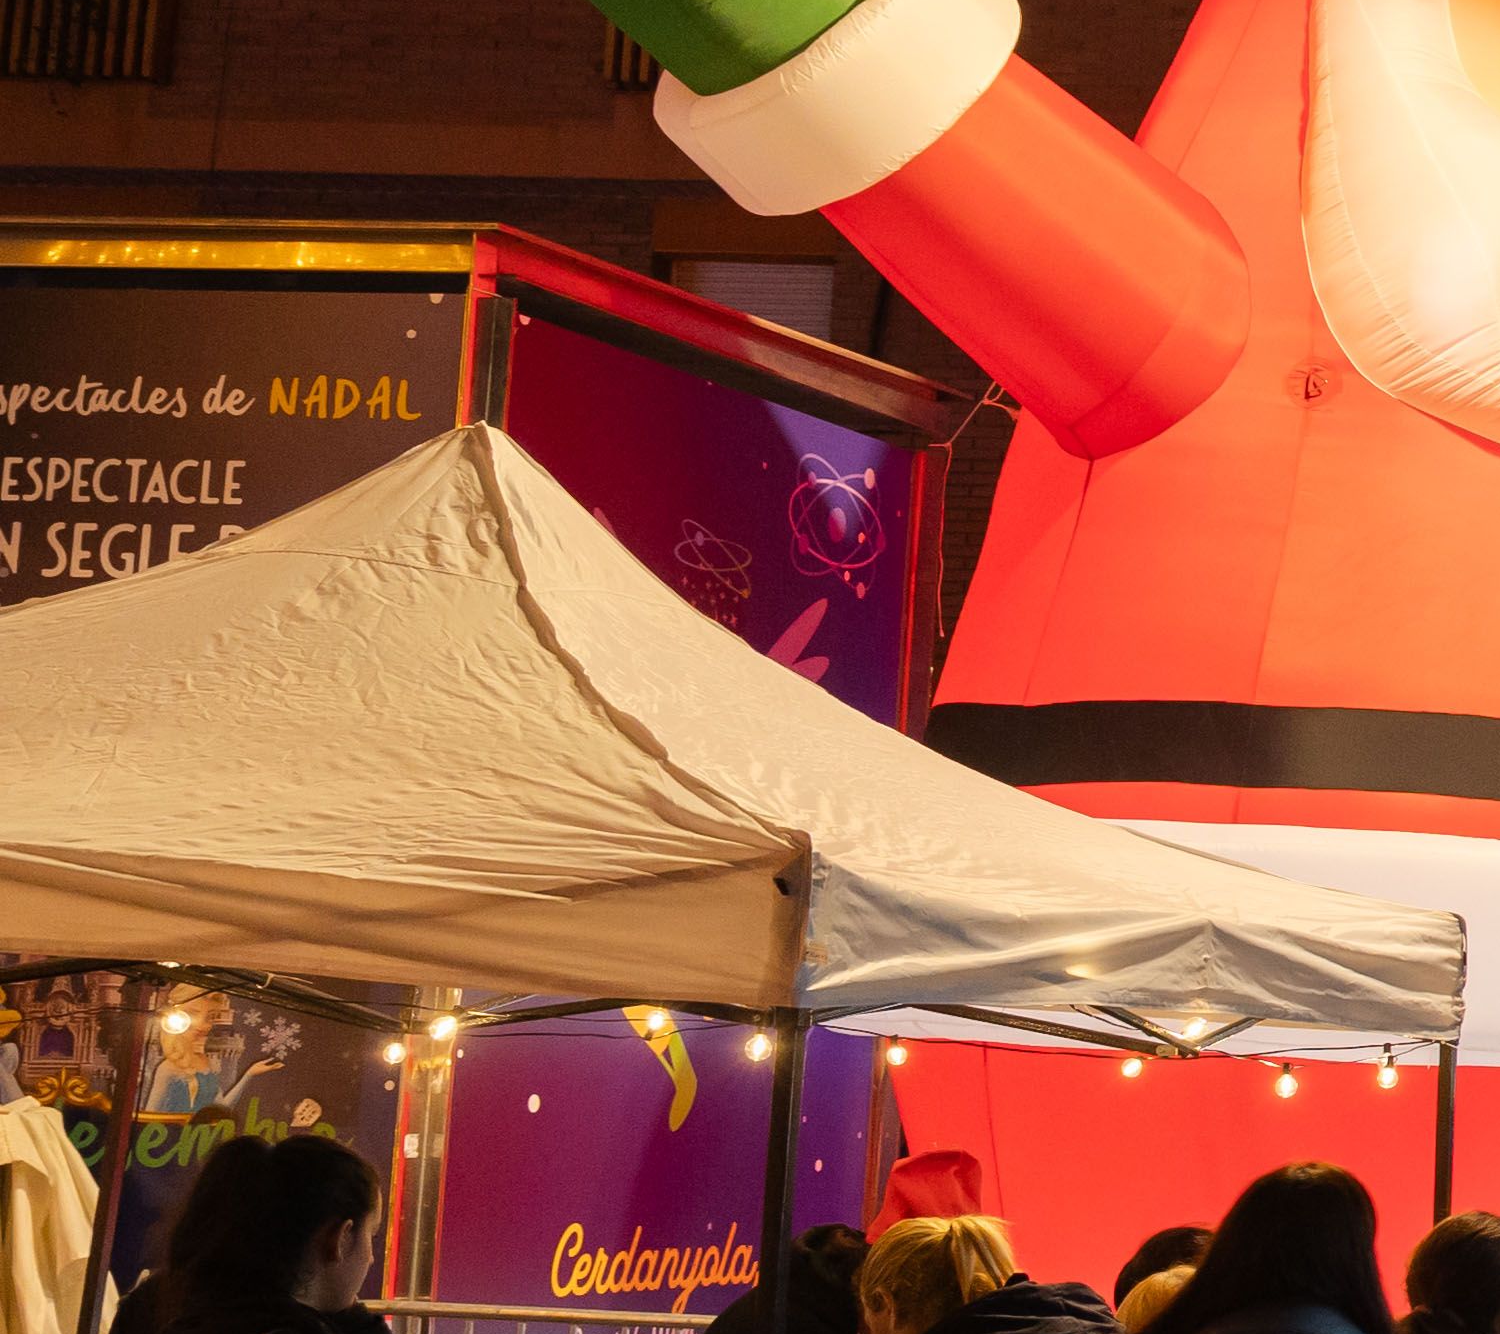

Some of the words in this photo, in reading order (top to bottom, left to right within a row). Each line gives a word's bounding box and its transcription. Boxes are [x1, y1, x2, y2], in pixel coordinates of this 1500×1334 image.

[203, 375, 255, 415] de
[270, 375, 421, 421] NADAL
[1, 457, 246, 504] ESPECTACLE
